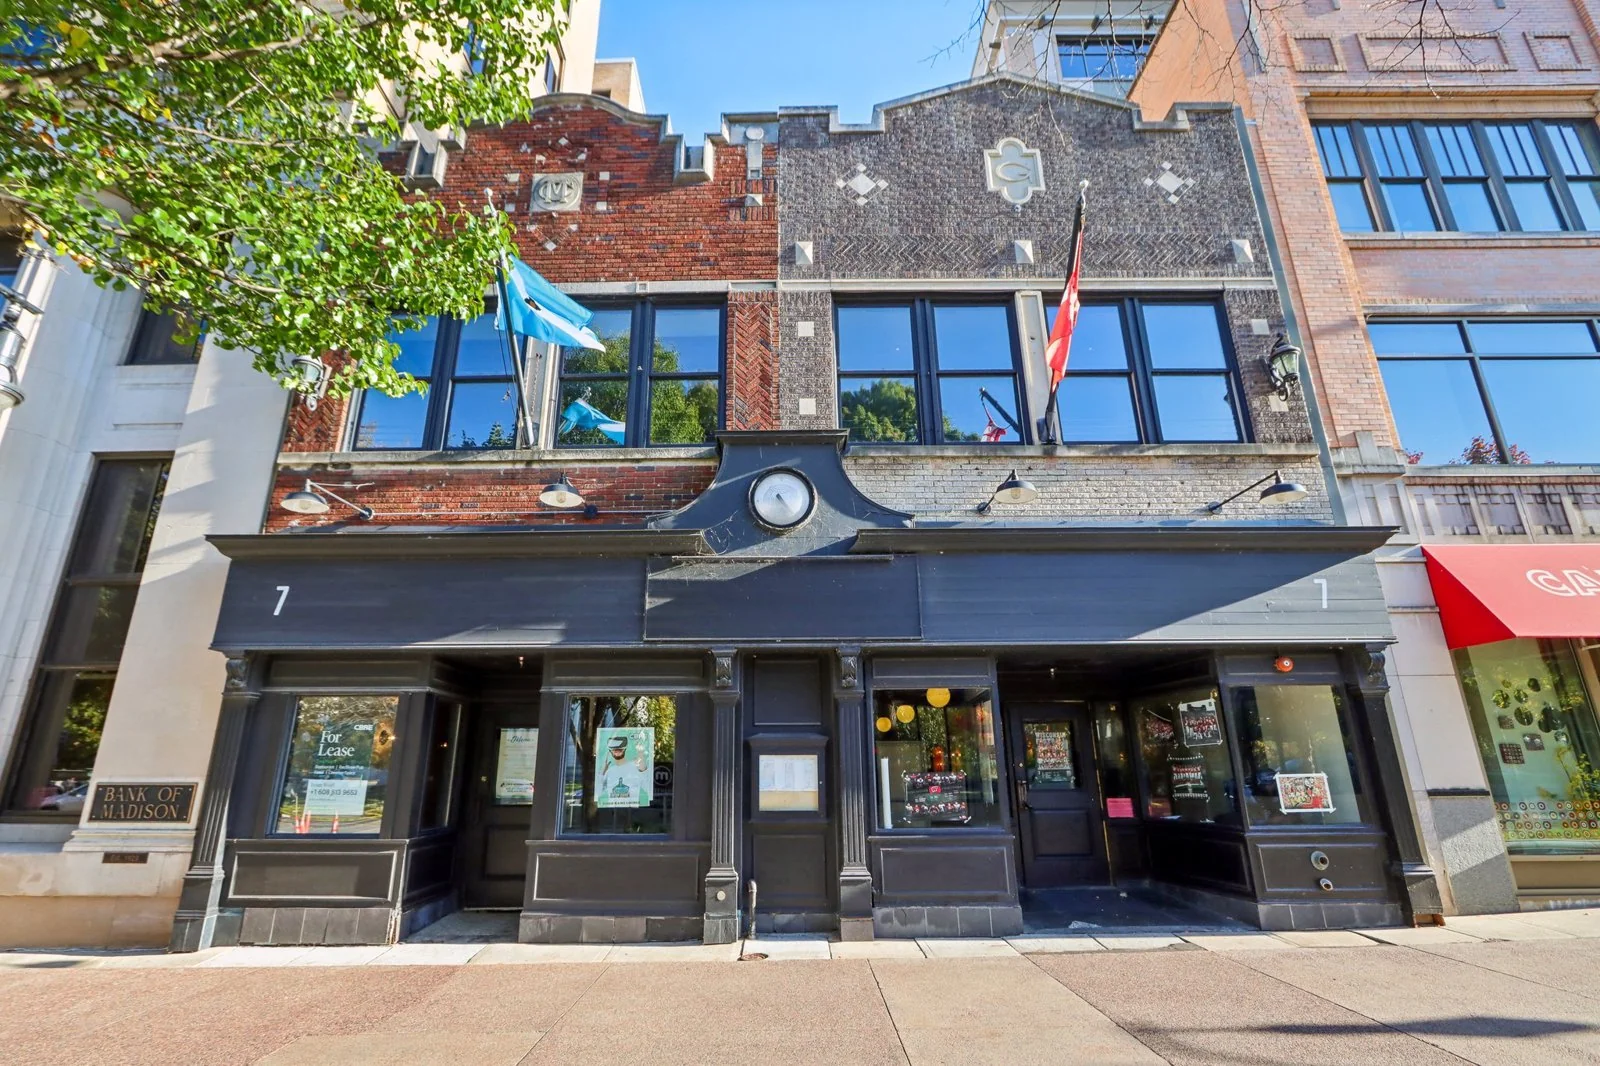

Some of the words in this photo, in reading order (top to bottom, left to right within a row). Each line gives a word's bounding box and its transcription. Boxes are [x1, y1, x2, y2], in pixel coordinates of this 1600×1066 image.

[273, 585, 290, 616] 7
[319, 731, 342, 743] For
[318, 744, 355, 757] Lease
[103, 786, 149, 802] BANK
[157, 786, 184, 802] OF
[101, 803, 180, 819] MADISON
